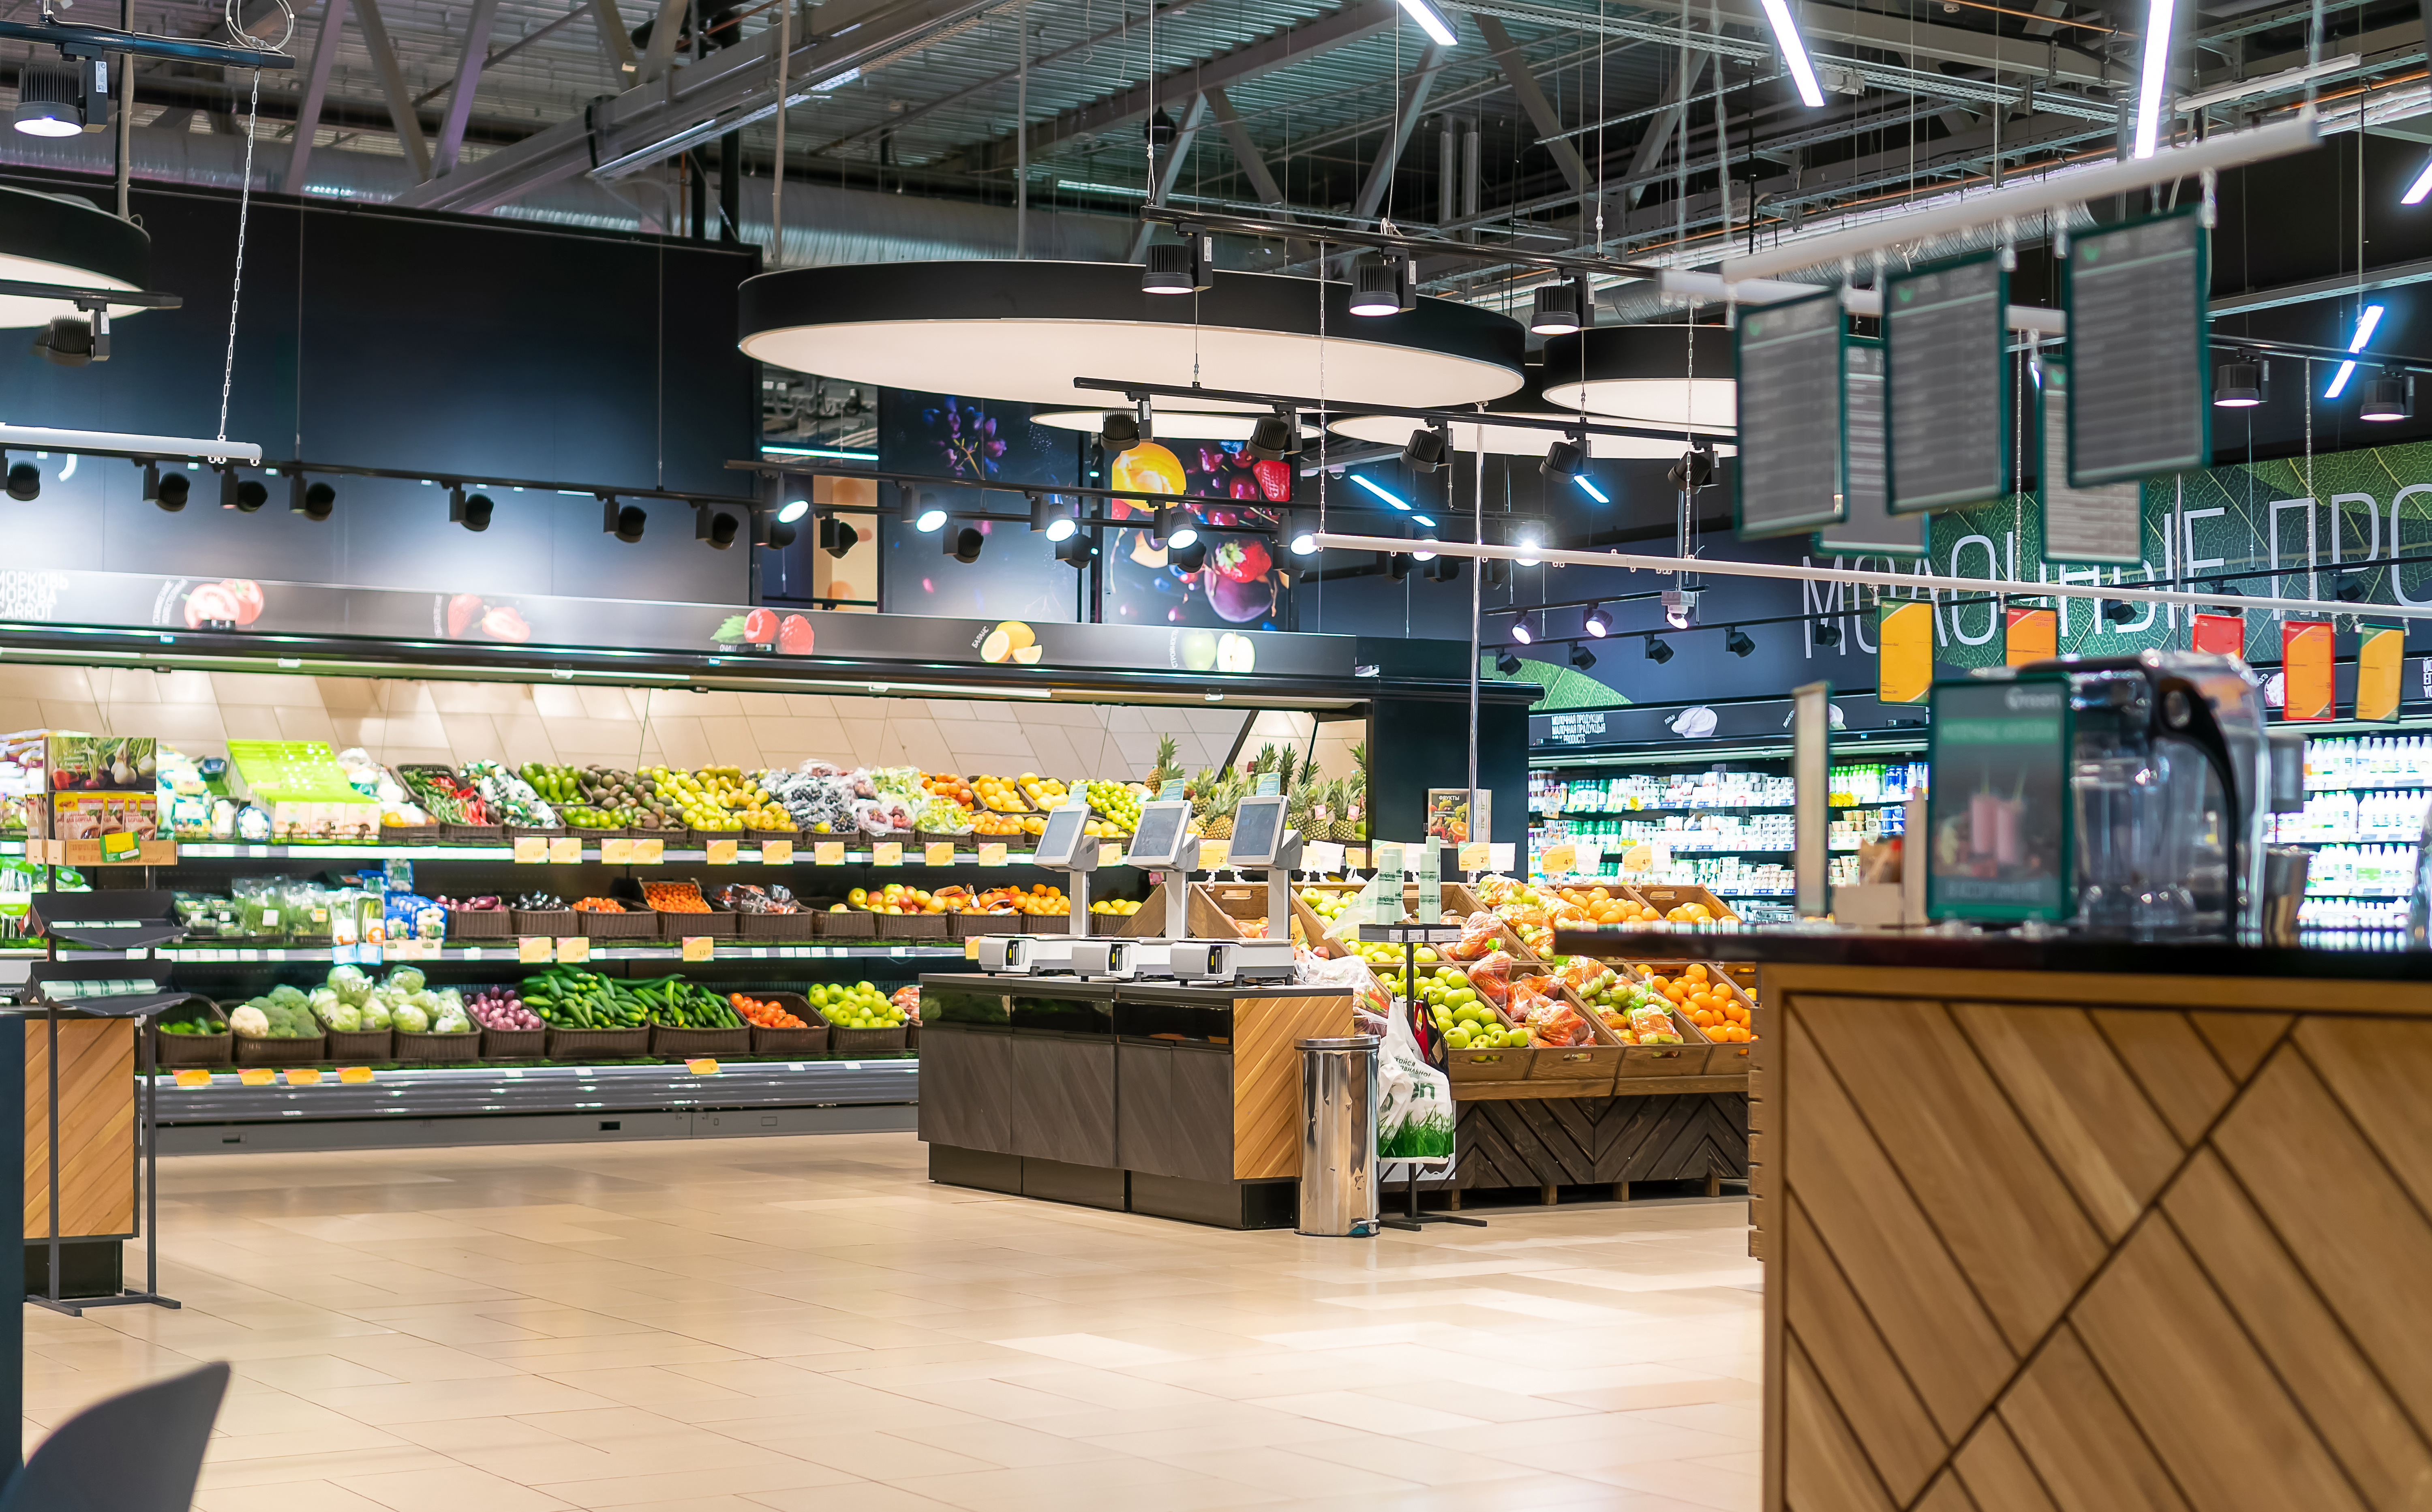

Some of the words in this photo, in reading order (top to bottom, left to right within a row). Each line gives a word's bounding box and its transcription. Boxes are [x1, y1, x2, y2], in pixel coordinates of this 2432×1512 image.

[971, 626, 989, 649] БАЛАНС
[1169, 629, 1179, 668] СТРОЙНОСТЬ
[1552, 715, 1576, 725] МОЛОЧНАЯ
[1576, 713, 1604, 725] ПРОДУКЦИЯ
[1552, 724, 1576, 735] МАЛОЧНАЯ
[1577, 723, 1606, 734] ПРАДУКЦЫЯ
[1563, 734, 1586, 744] PRODUCTS
